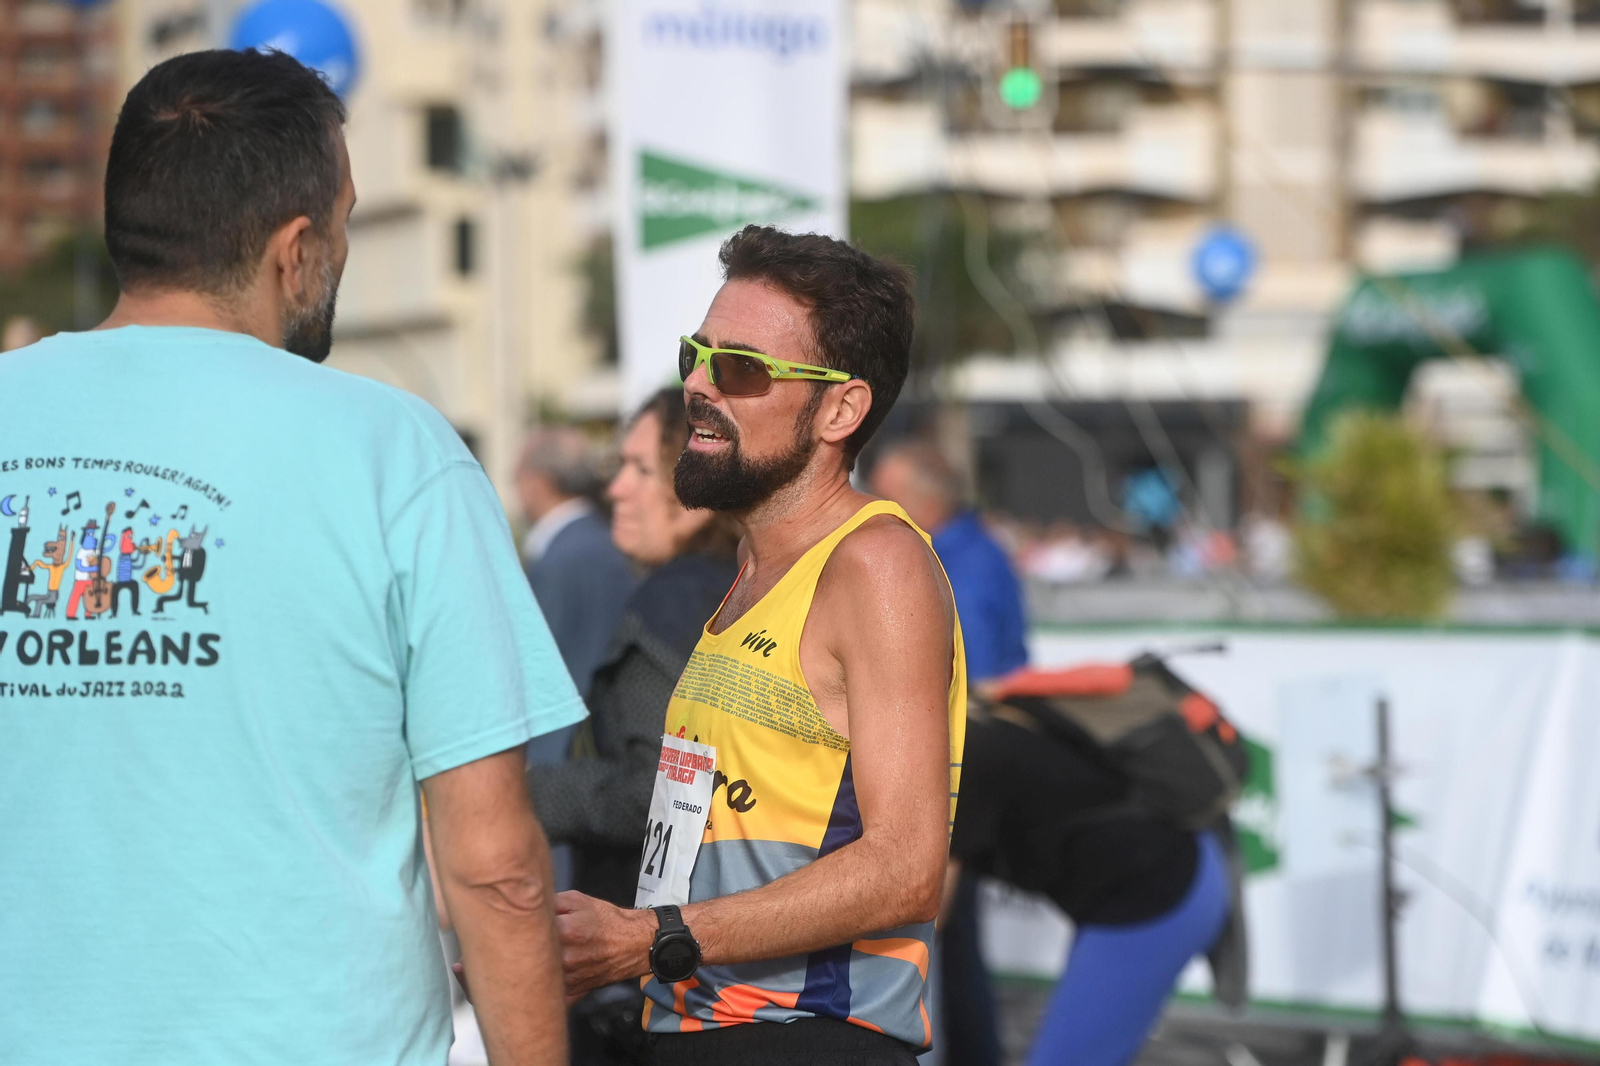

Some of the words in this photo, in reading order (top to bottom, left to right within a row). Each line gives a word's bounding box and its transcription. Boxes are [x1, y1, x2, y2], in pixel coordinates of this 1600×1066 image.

[0, 459, 19, 472] ES
[25, 456, 66, 470] BONS
[72, 457, 122, 472] TEMPS
[124, 460, 185, 485] ROULER!
[184, 476, 232, 511] AGAIN!
[16, 629, 221, 667] ORLEANS
[79, 681, 125, 698] JAZZ
[130, 681, 185, 699] 2022
[767, 689, 795, 704] ATLETISMO
[773, 686, 786, 695] CLUB
[776, 704, 789, 712] CLUB
[796, 706, 808, 716] CLUB
[672, 800, 702, 814] FEDERADO
